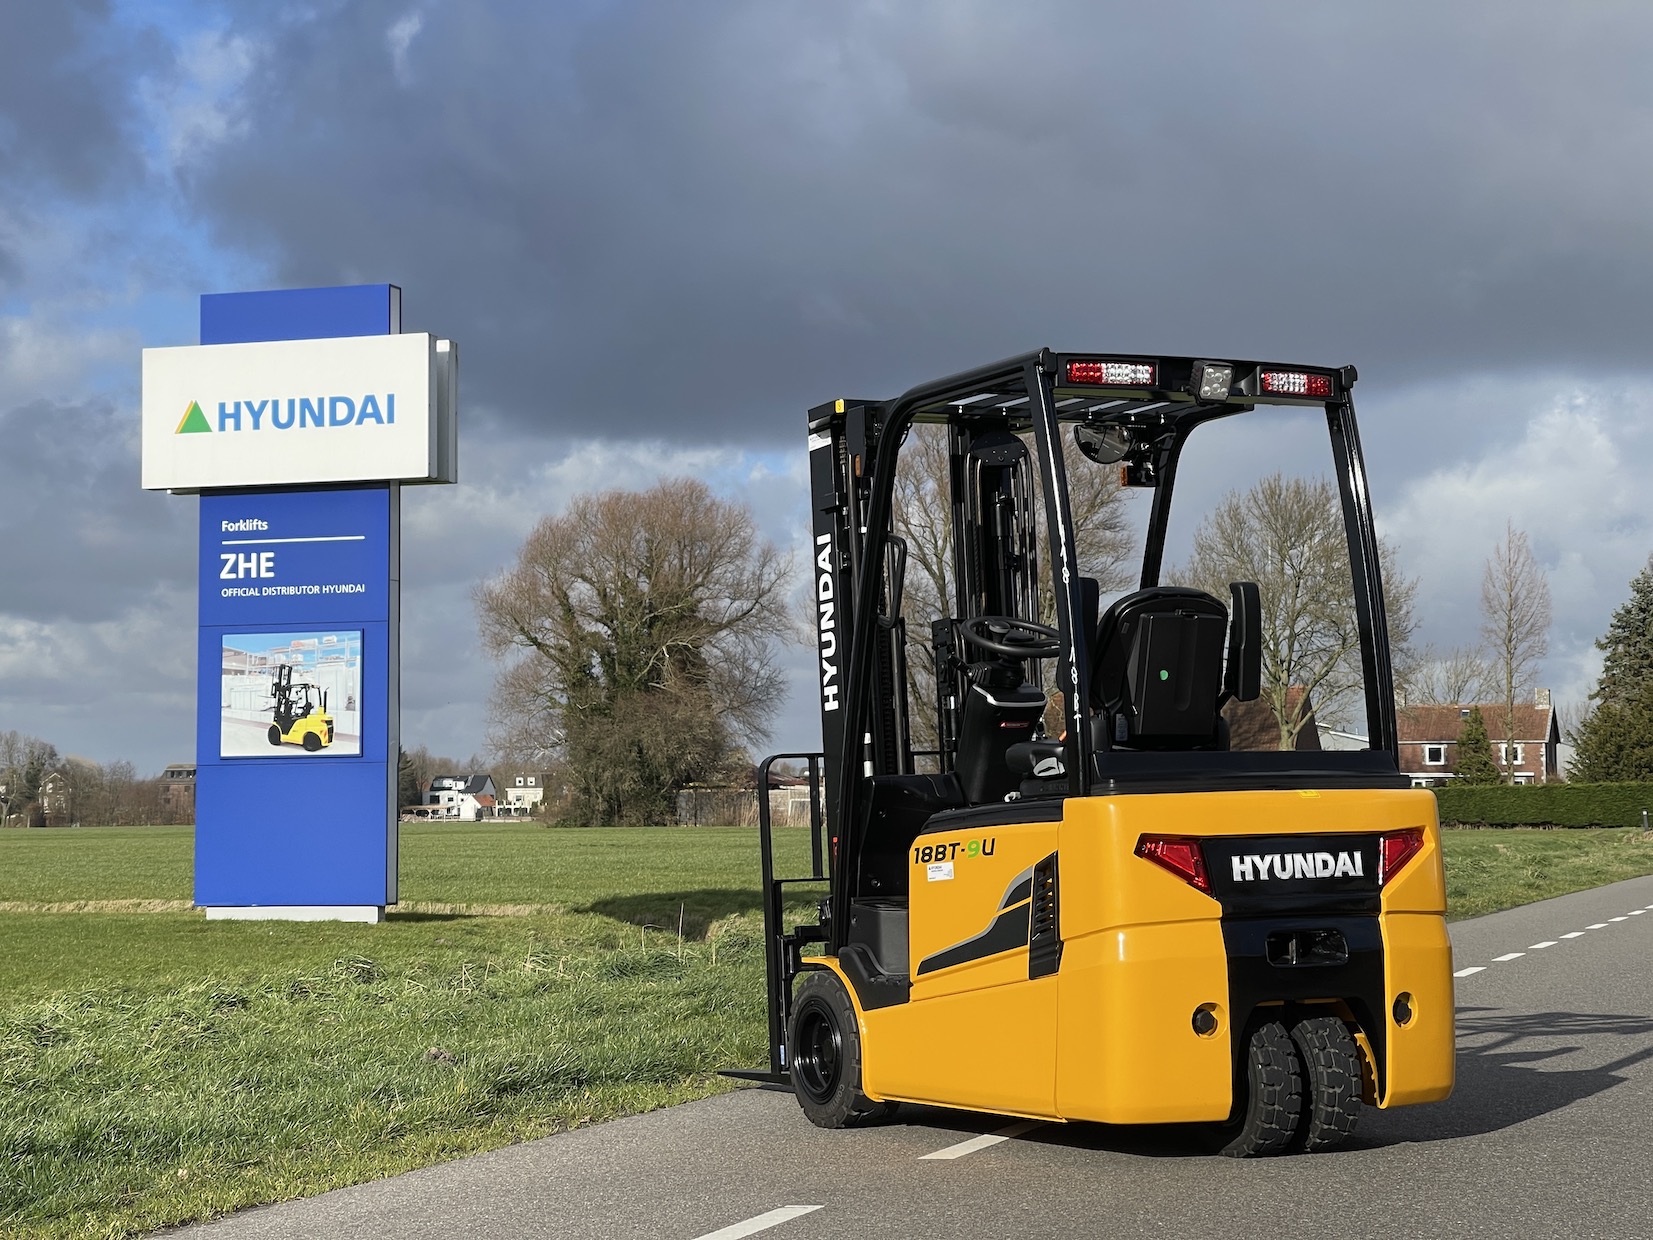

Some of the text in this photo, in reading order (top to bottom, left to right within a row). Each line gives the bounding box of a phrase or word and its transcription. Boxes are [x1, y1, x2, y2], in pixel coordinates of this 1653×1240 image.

[217, 393, 395, 432] HYUNDAI
[221, 518, 268, 532] Forklifts
[219, 551, 275, 579] ZHE
[221, 583, 366, 598] OFFICIAL DISTRIBUTOR HYUNDAI
[816, 532, 839, 712] HYUNDAI
[914, 837, 996, 864] 18BT-9U
[1231, 850, 1365, 882] HYUNDAI
